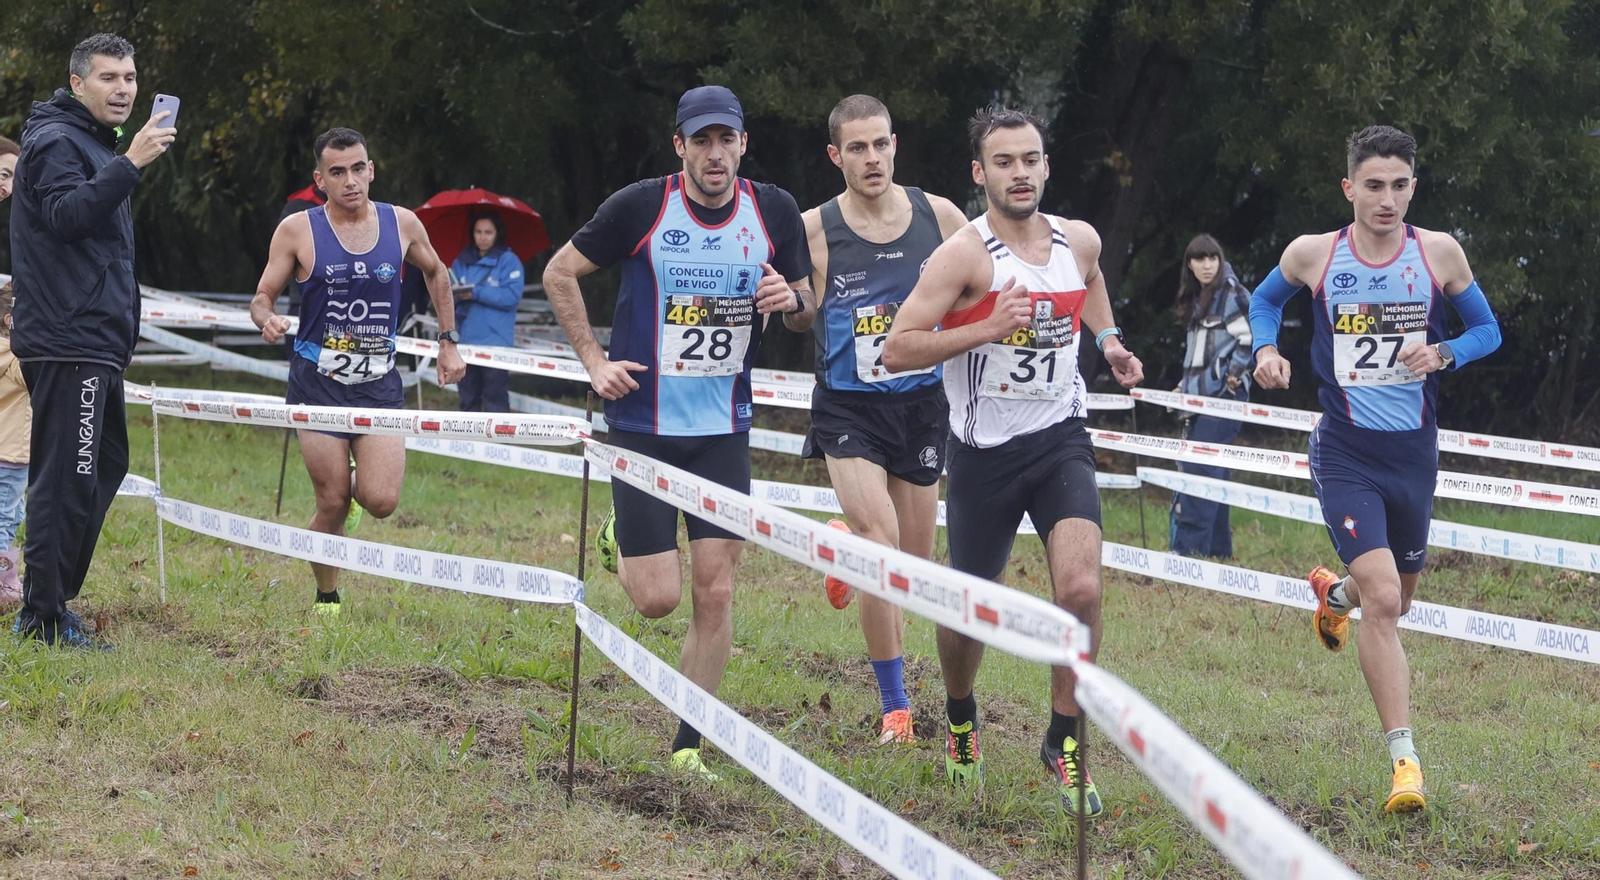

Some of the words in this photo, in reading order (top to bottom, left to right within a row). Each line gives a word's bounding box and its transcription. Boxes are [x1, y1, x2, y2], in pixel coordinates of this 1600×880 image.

[660, 246, 690, 254] NIPOCAR
[669, 267, 724, 278] CONCELLO
[676, 280, 689, 288] DE
[692, 280, 716, 290] VIGO
[667, 305, 708, 326] 46º
[714, 306, 752, 314] BELARMINO
[1386, 304, 1426, 313] MEMORIAL
[1336, 314, 1375, 334] 46º
[1382, 312, 1426, 322] BELARMINO
[856, 315, 892, 334] 46º
[1394, 321, 1425, 329] ALONSO
[680, 328, 732, 361] 28
[873, 336, 886, 366] 2
[1354, 336, 1404, 369] 27
[332, 354, 372, 378] 24
[1010, 349, 1056, 383] 31
[777, 390, 801, 401] CONCELLO
[802, 393, 810, 402] DE
[1206, 401, 1226, 411] CONCELLO
[1227, 403, 1232, 412] DE
[1233, 404, 1242, 413] VIGO
[1271, 410, 1292, 420] CONCELLO
[1293, 413, 1299, 421] DE
[1300, 414, 1310, 422] VIGO
[77, 377, 95, 474] RUNGALICIA
[1124, 435, 1155, 447] CONCELLO
[1156, 438, 1164, 448] DE
[1164, 439, 1179, 450] VIGO
[1439, 434, 1446, 442] DE
[1446, 434, 1458, 444] VIGO
[1493, 440, 1518, 451] CONCELLO
[1519, 444, 1526, 452] DE
[1527, 444, 1539, 454] VIGO
[1222, 448, 1255, 462] CONCELLO
[1256, 453, 1265, 463] DE
[1265, 454, 1281, 465] VIGO
[1577, 451, 1600, 462] CONCELL
[1443, 478, 1480, 493] CONCELLO
[1482, 483, 1492, 493] DE
[1495, 485, 1512, 497] VIGO
